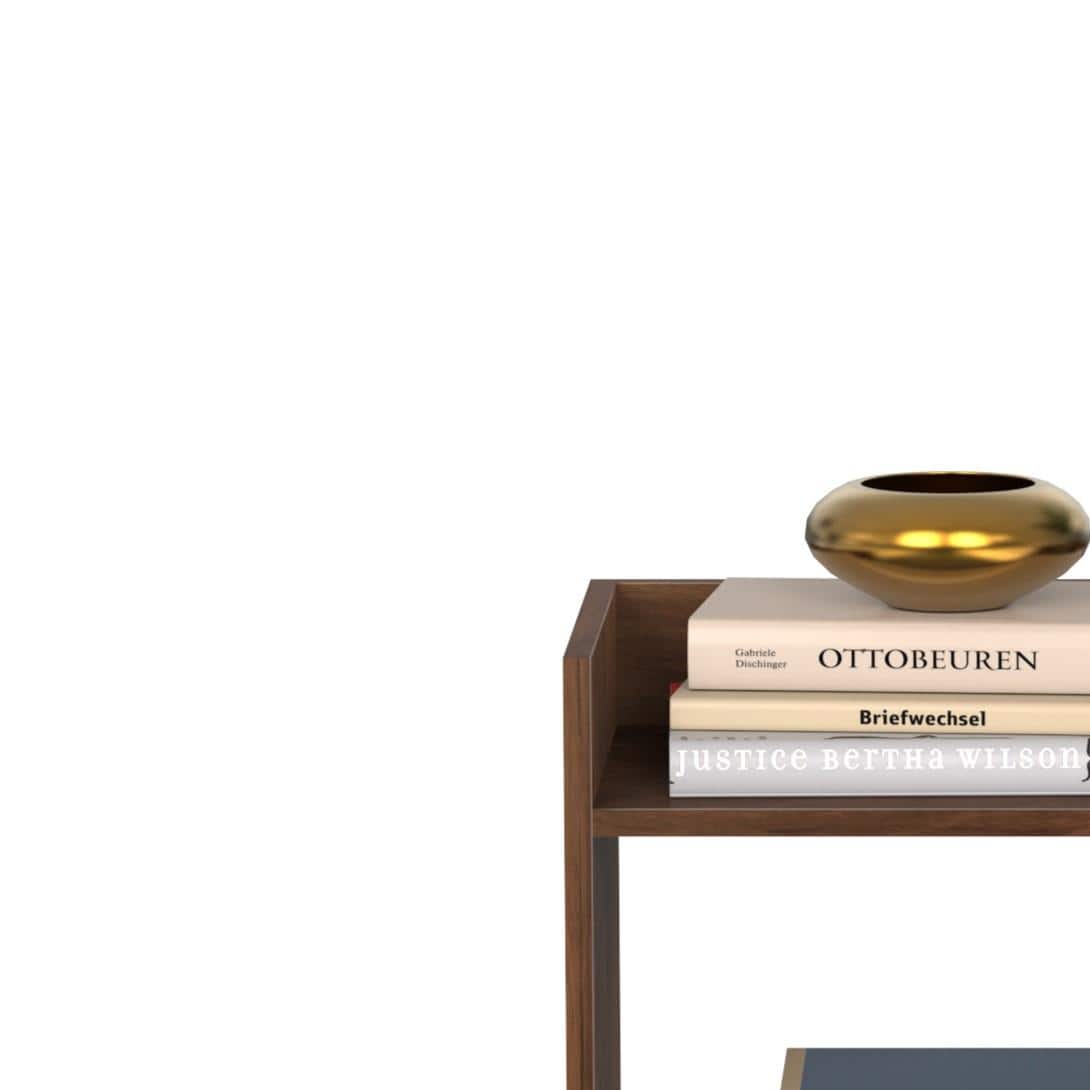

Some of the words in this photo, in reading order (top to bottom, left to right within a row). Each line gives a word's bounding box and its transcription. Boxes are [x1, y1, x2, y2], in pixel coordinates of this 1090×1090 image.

[735, 648, 776, 657] Gabriele
[735, 659, 787, 669] Dischinger
[818, 648, 1039, 671] OTTOBEUREN
[859, 709, 986, 726] Briefwechsel
